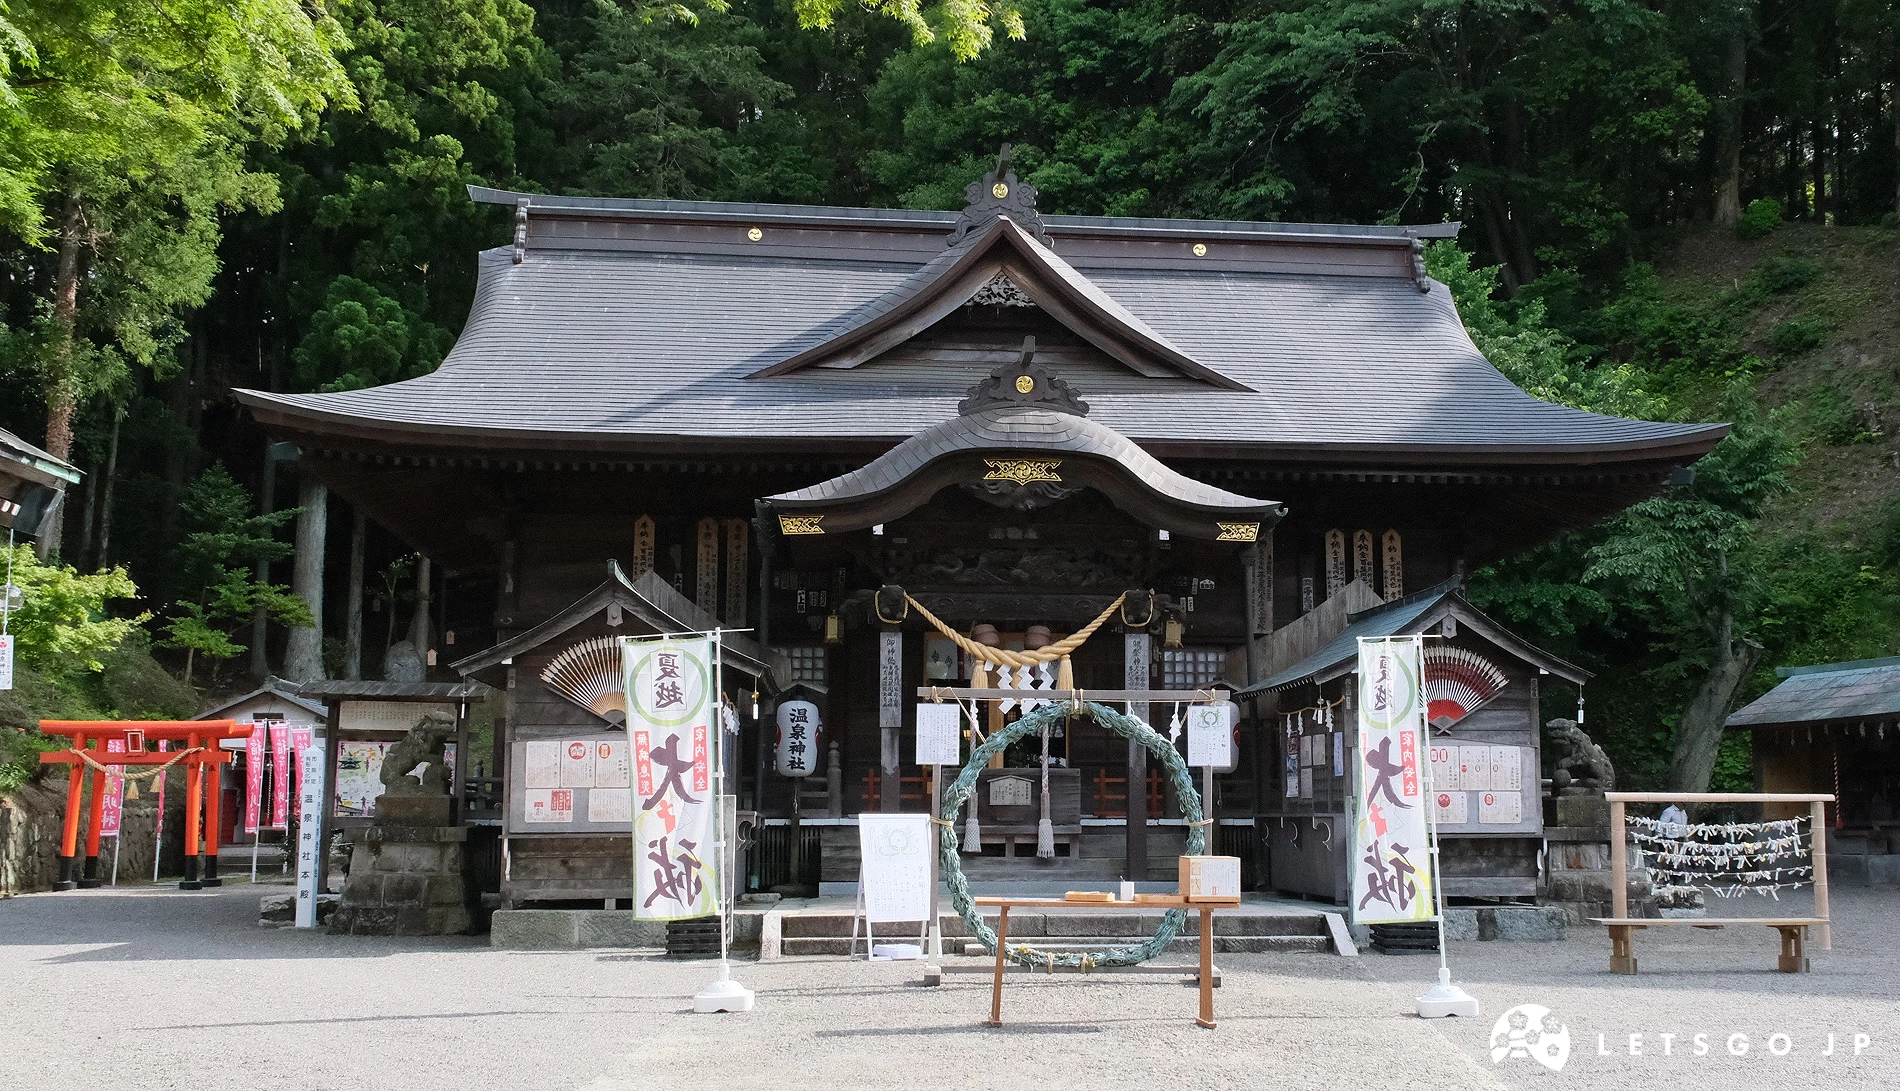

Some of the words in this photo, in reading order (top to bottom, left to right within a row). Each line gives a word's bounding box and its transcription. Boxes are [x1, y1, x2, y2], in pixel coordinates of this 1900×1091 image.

[787, 708, 809, 771] 温泉神社
[300, 794, 313, 899] 温泉神社本殿
